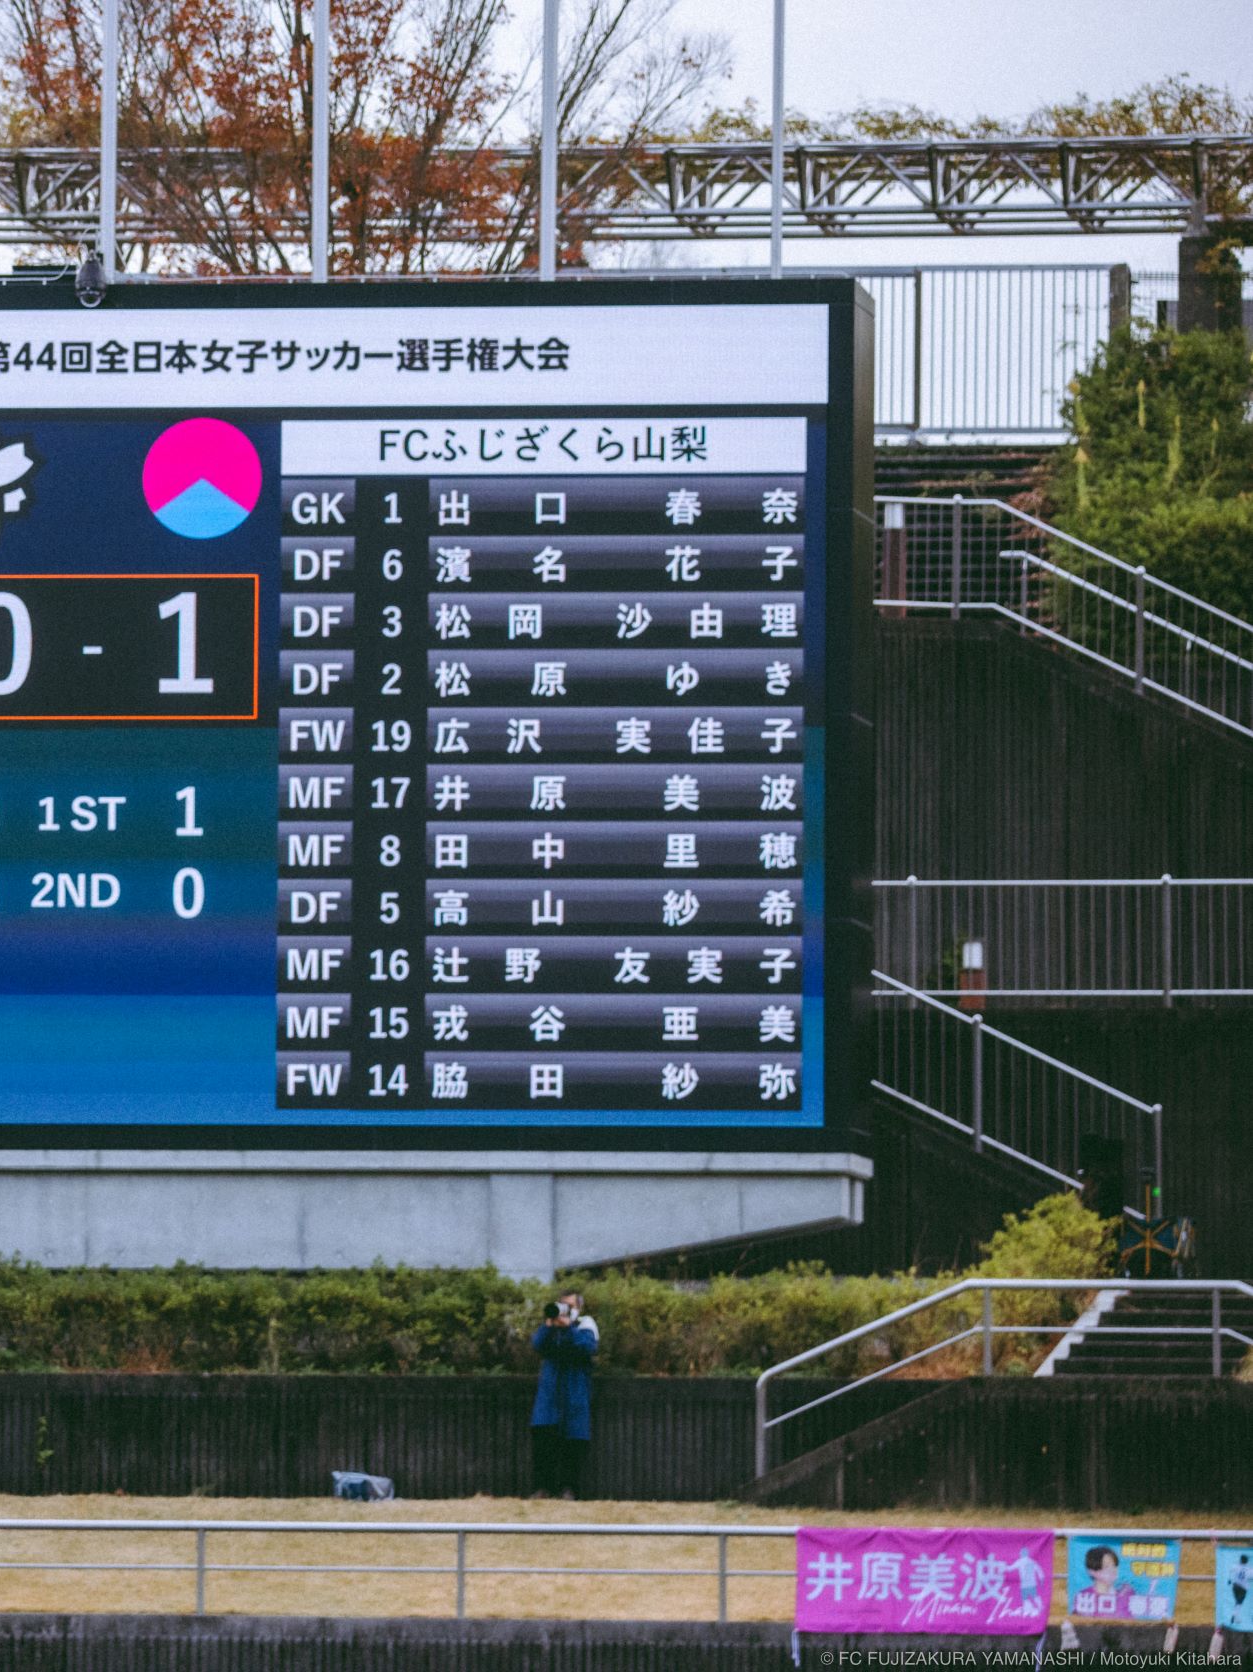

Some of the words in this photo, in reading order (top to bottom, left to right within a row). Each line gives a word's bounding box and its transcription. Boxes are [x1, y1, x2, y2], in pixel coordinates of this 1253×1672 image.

[379, 425, 708, 463] FCふじざくら山梨
[291, 492, 345, 525] GK
[384, 492, 403, 523] 1
[294, 548, 344, 581] DF
[382, 549, 403, 581] 6
[293, 605, 344, 637] DF
[382, 605, 402, 638] 3
[158, 592, 214, 693] 1
[293, 662, 343, 695] DF
[381, 663, 401, 695] 2
[290, 719, 346, 752] FW
[372, 720, 411, 752] 19
[288, 776, 346, 809] MF
[371, 777, 410, 808] 17
[175, 786, 204, 837] 1
[288, 834, 345, 866] MF
[380, 835, 401, 867] 8
[30, 872, 121, 908] 2ND
[172, 867, 205, 919] 0
[290, 891, 342, 923] DF
[380, 892, 400, 924] 5
[287, 948, 344, 980] MF
[370, 949, 409, 981] 16
[286, 1006, 344, 1038] MF
[369, 1007, 409, 1039] 15
[287, 1063, 343, 1096] FW
[369, 1064, 409, 1096] 14
[806, 1552, 1008, 1601] 井原美波
